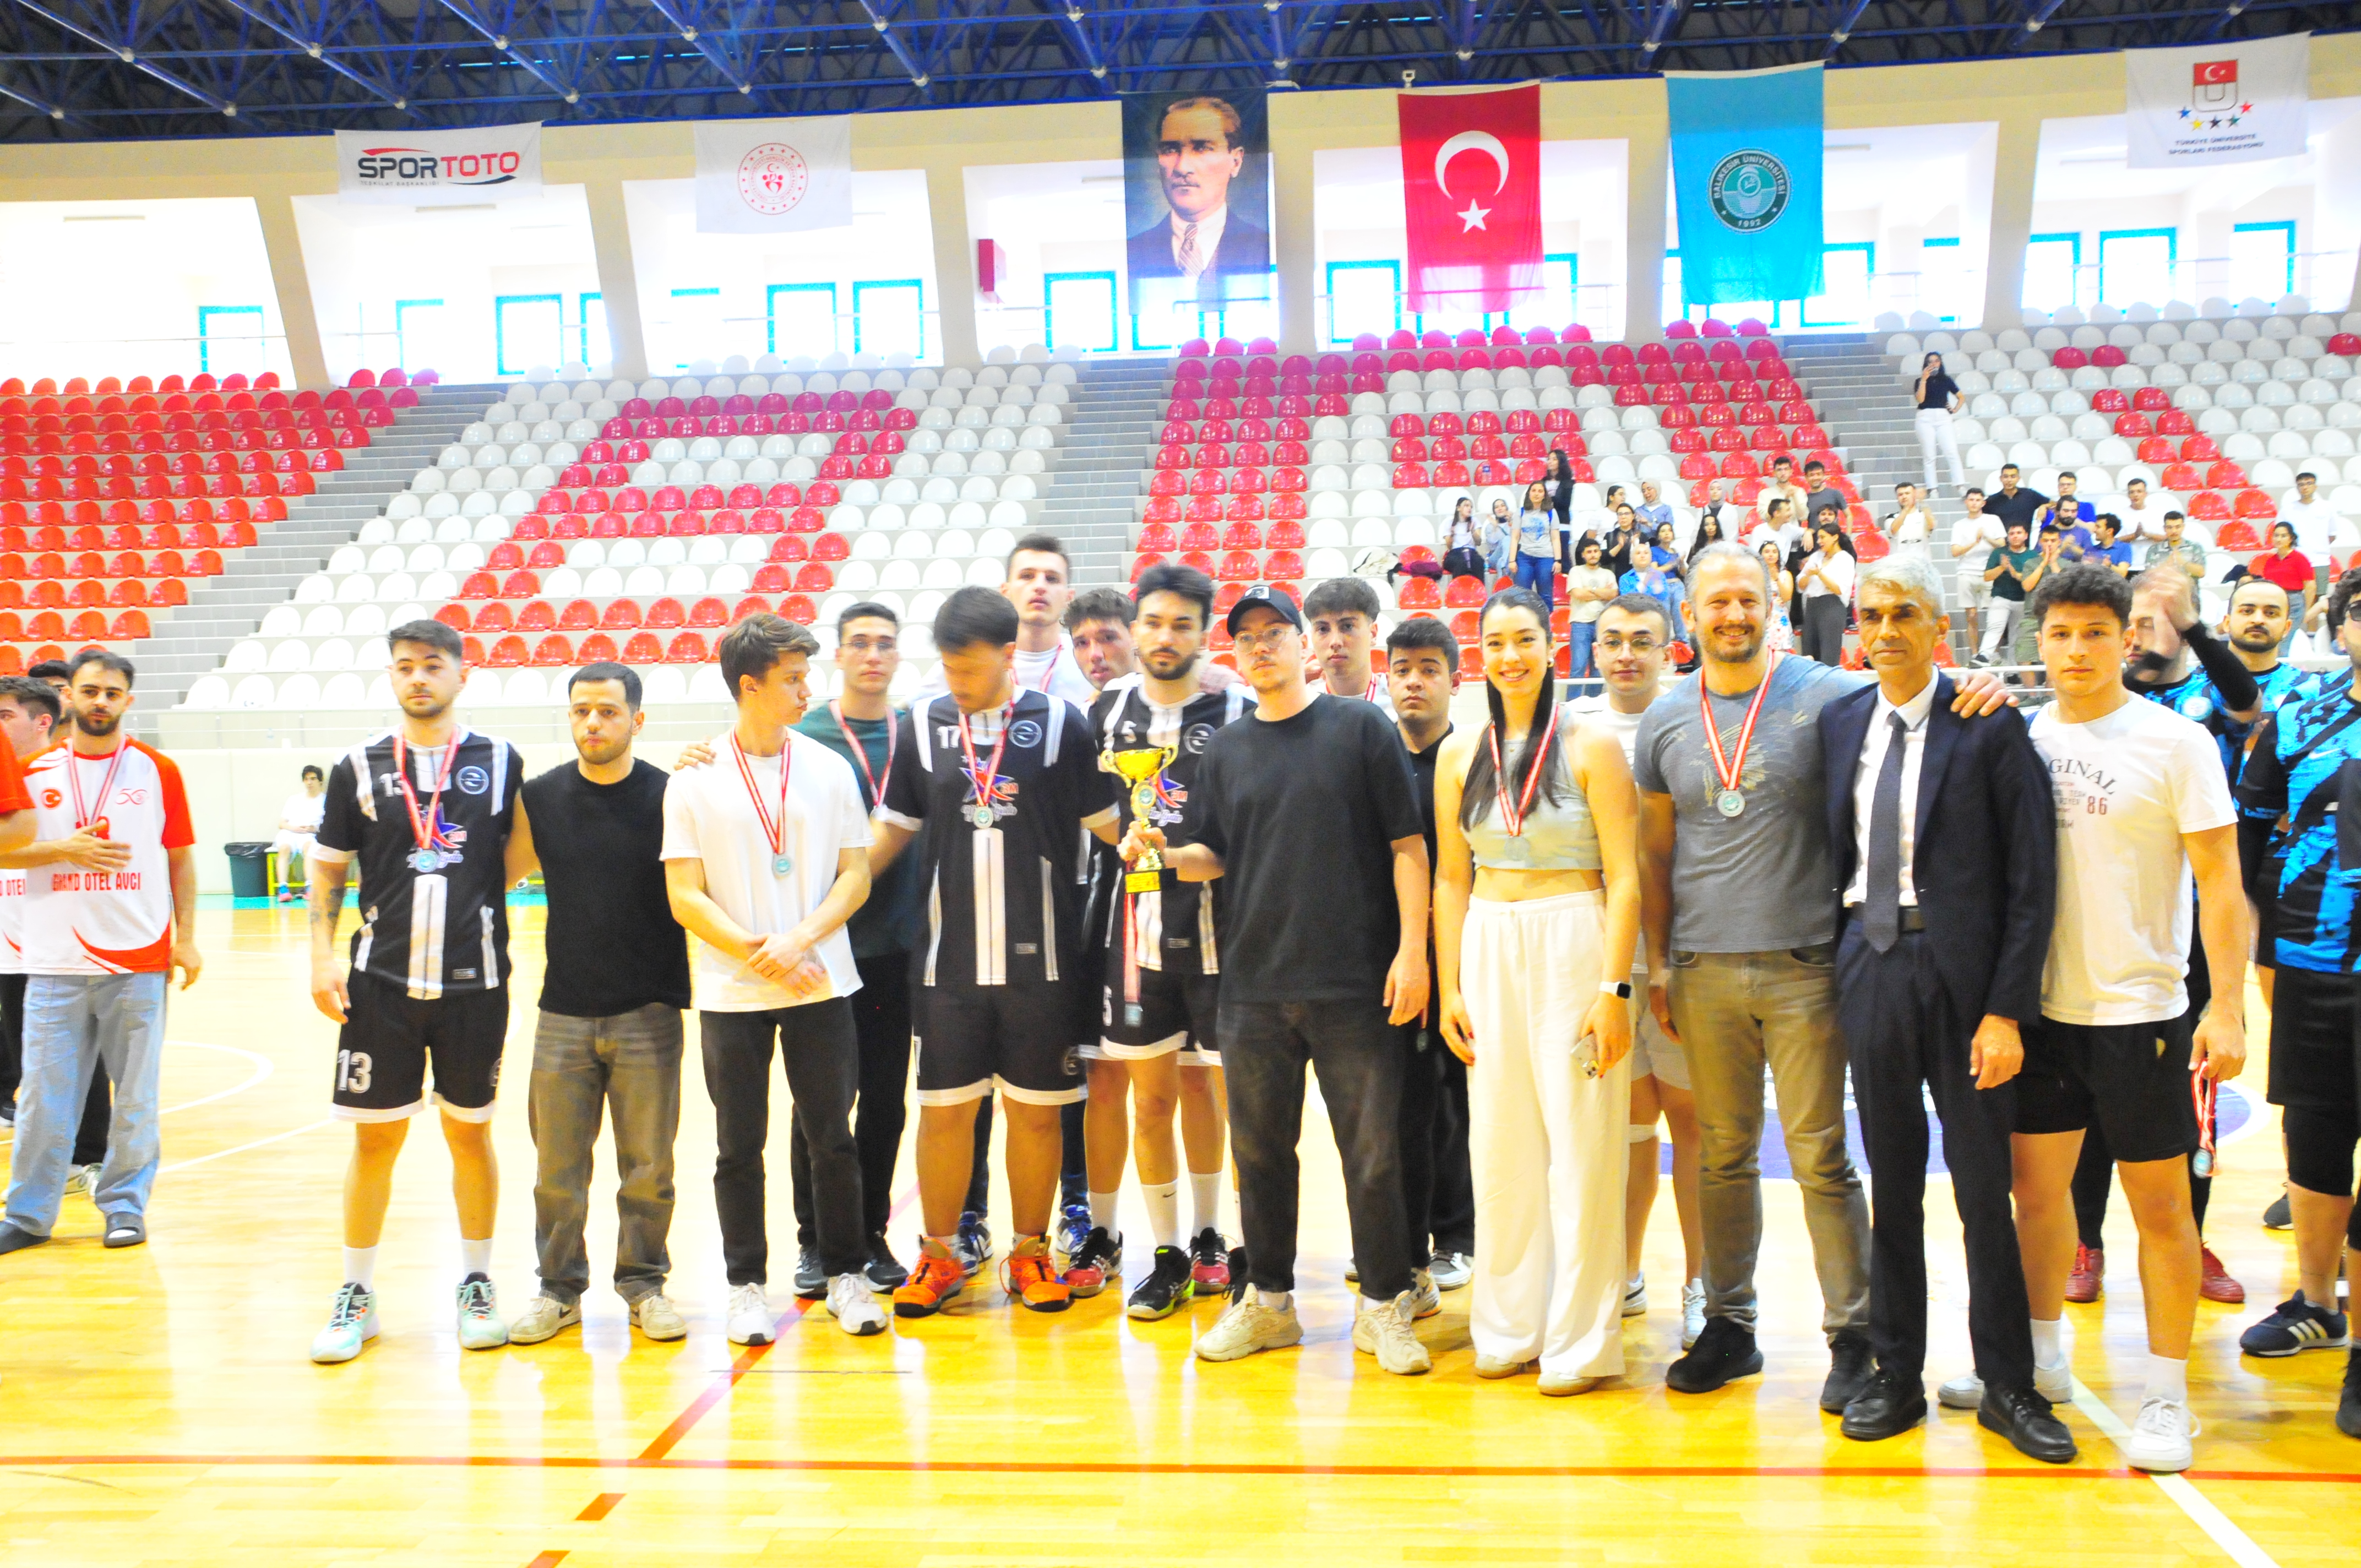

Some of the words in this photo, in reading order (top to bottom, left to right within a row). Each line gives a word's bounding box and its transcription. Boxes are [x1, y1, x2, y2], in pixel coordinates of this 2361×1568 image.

[1738, 219, 1761, 227] 1992
[937, 726, 961, 749] 17
[379, 772, 405, 797] 13
[2048, 758, 2117, 795] GINAL
[2086, 796, 2108, 815] 86
[85, 872, 112, 891] OTEL
[116, 872, 142, 890] AVCI
[337, 1049, 372, 1094] 13
